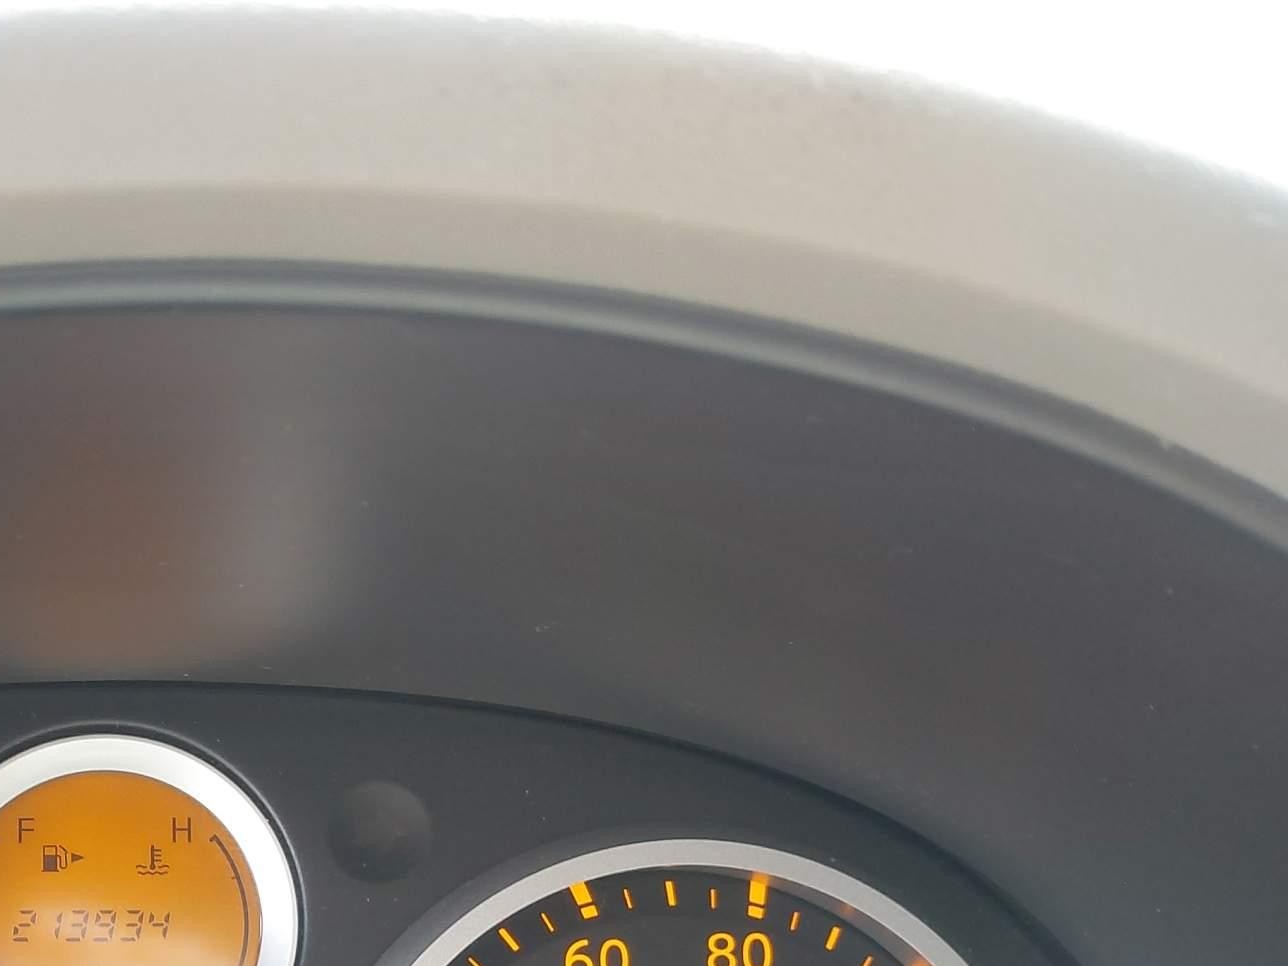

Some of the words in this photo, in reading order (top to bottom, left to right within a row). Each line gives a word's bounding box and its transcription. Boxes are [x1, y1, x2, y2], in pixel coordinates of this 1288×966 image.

[18, 816, 36, 844] F
[171, 816, 192, 843] H
[13, 909, 171, 942] 213934
